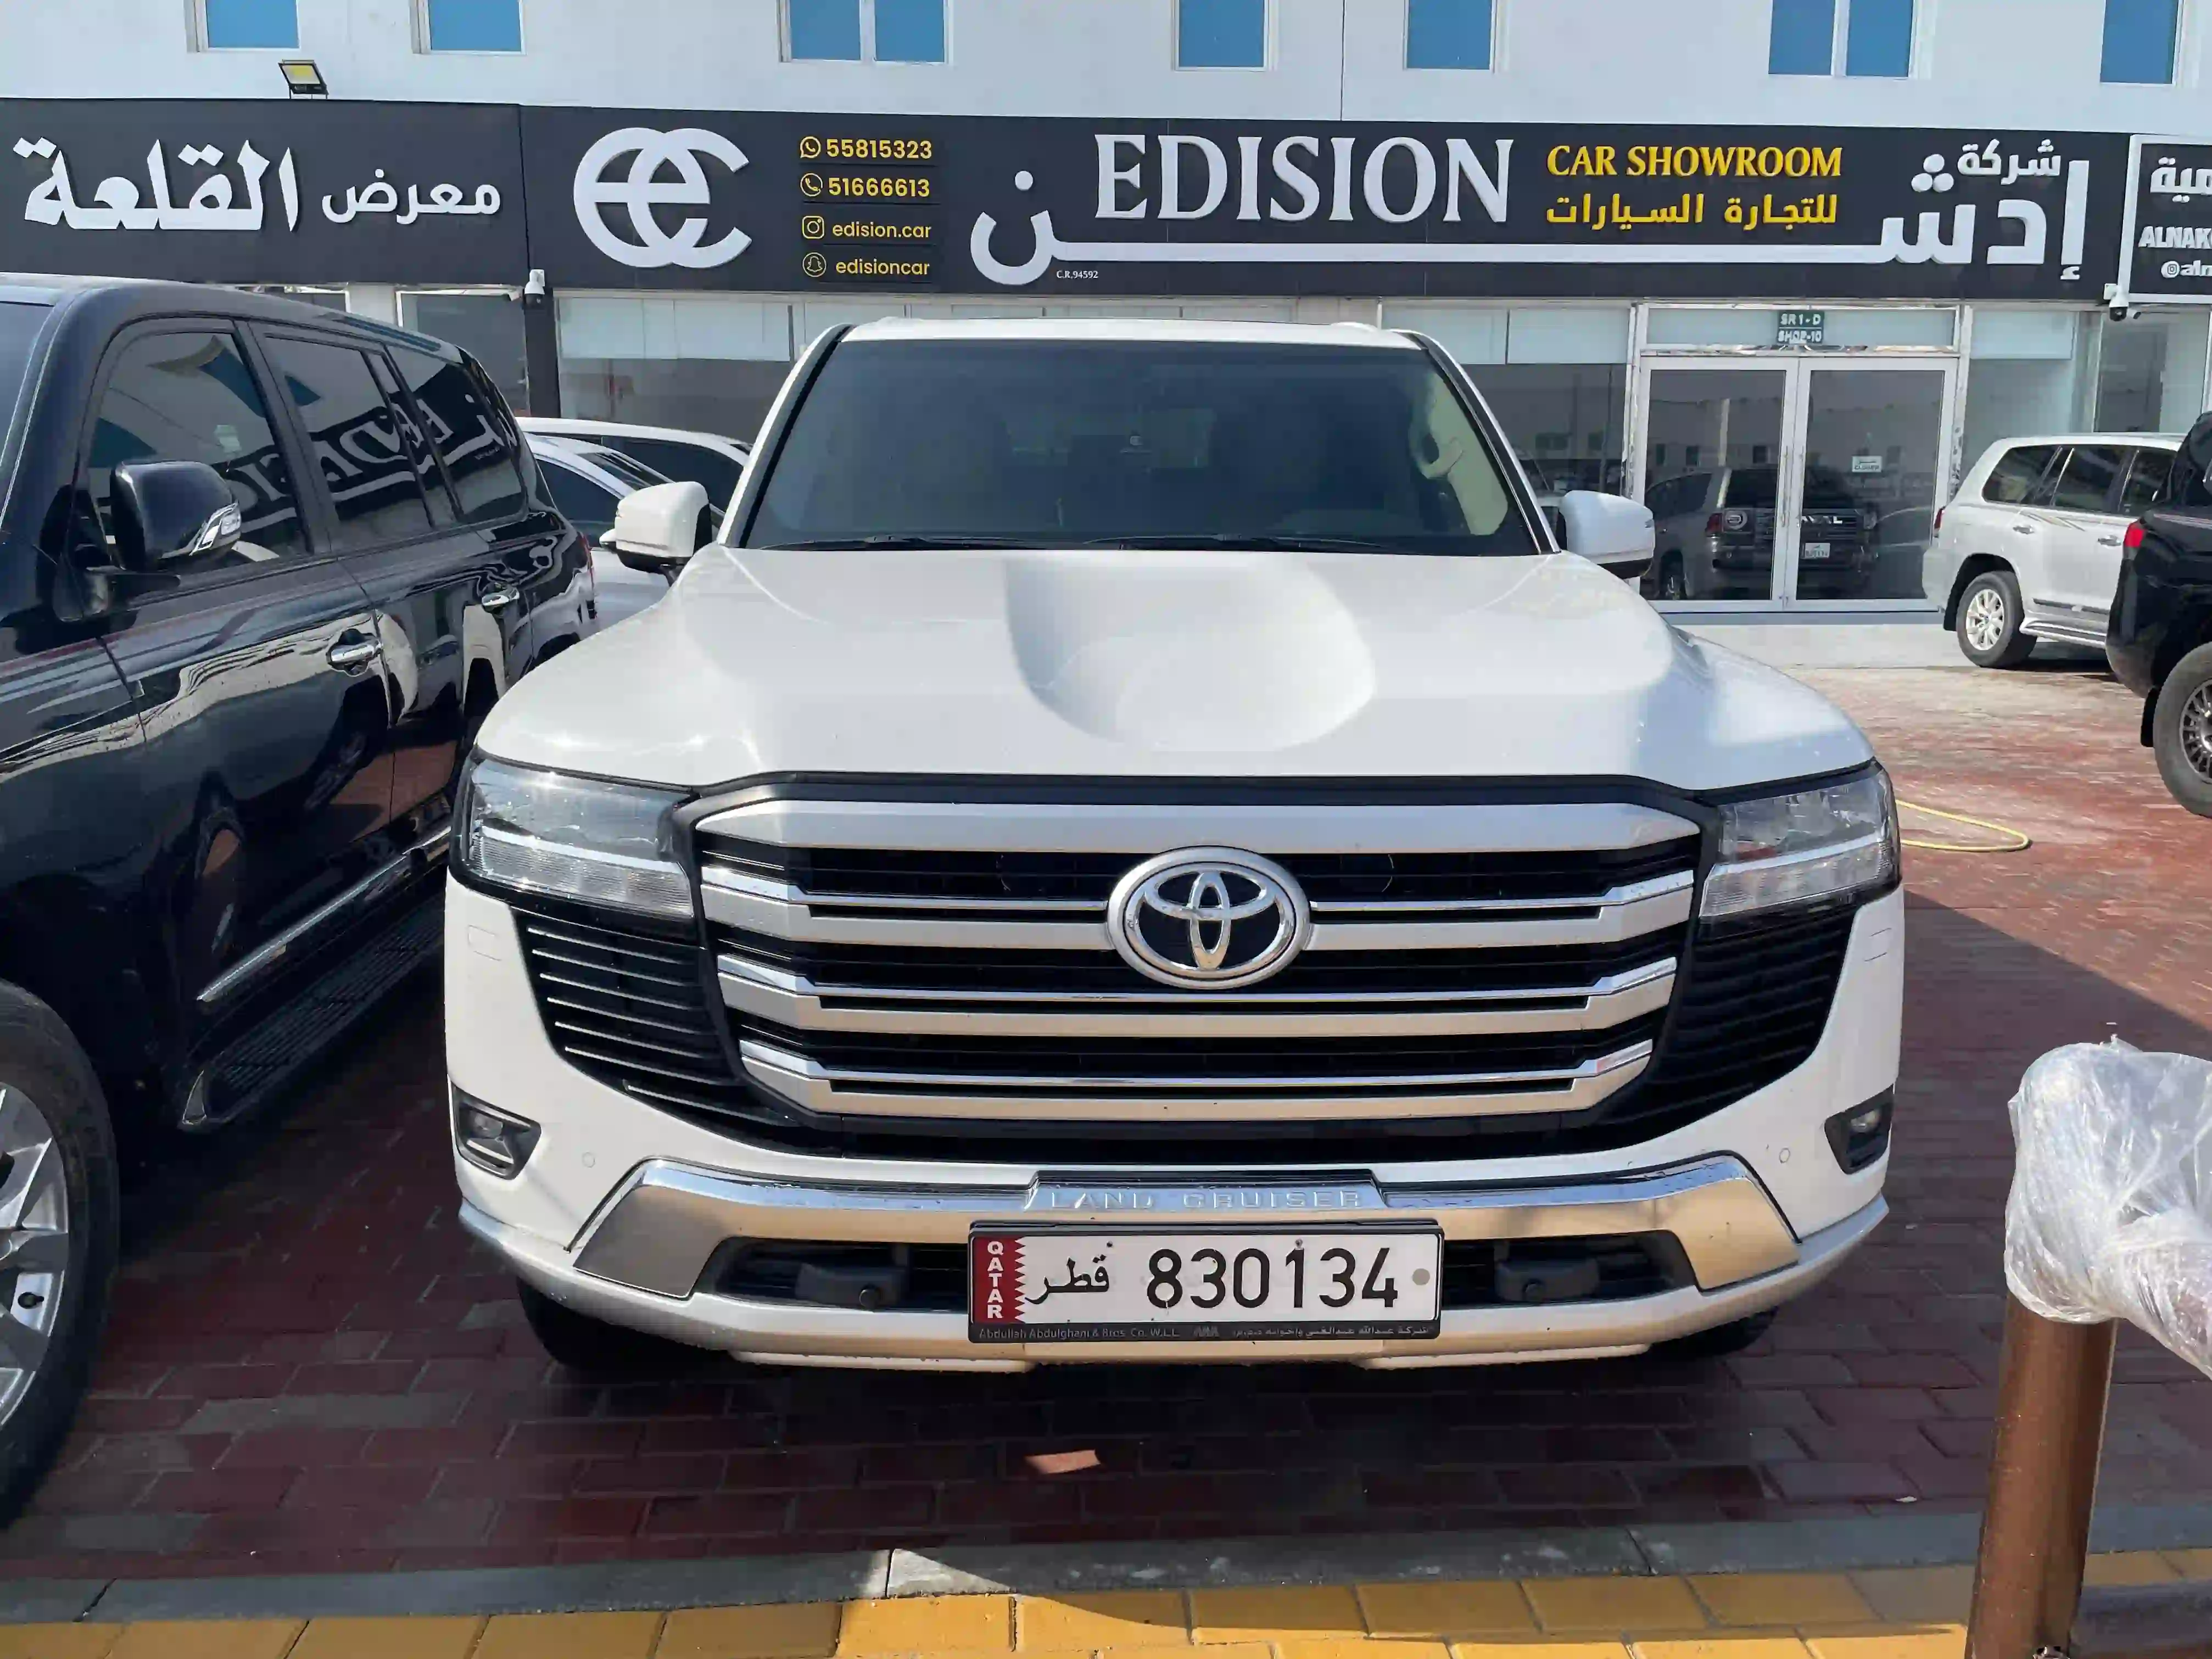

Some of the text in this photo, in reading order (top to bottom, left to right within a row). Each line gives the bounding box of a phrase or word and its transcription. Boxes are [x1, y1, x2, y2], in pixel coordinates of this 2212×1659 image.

[826, 138, 932, 159] 55815323
[1546, 145, 1843, 177] CAR SHOWROOM
[1957, 138, 2062, 185] شركة
[13, 137, 501, 232] معرض القلعة
[828, 177, 930, 197] 51666613
[1094, 133, 1514, 223] EDISION
[832, 221, 932, 238] edision.car
[1546, 193, 1837, 231] للتجارة السيارات
[835, 258, 930, 275] edisioncar
[1051, 1189, 1362, 1209] LAND CRUISER
[987, 1241, 1004, 1319] QATAR
[1025, 1253, 1109, 1305] قطر
[1147, 1247, 1398, 1309] 830134
[979, 1327, 1027, 1339] Abdullah
